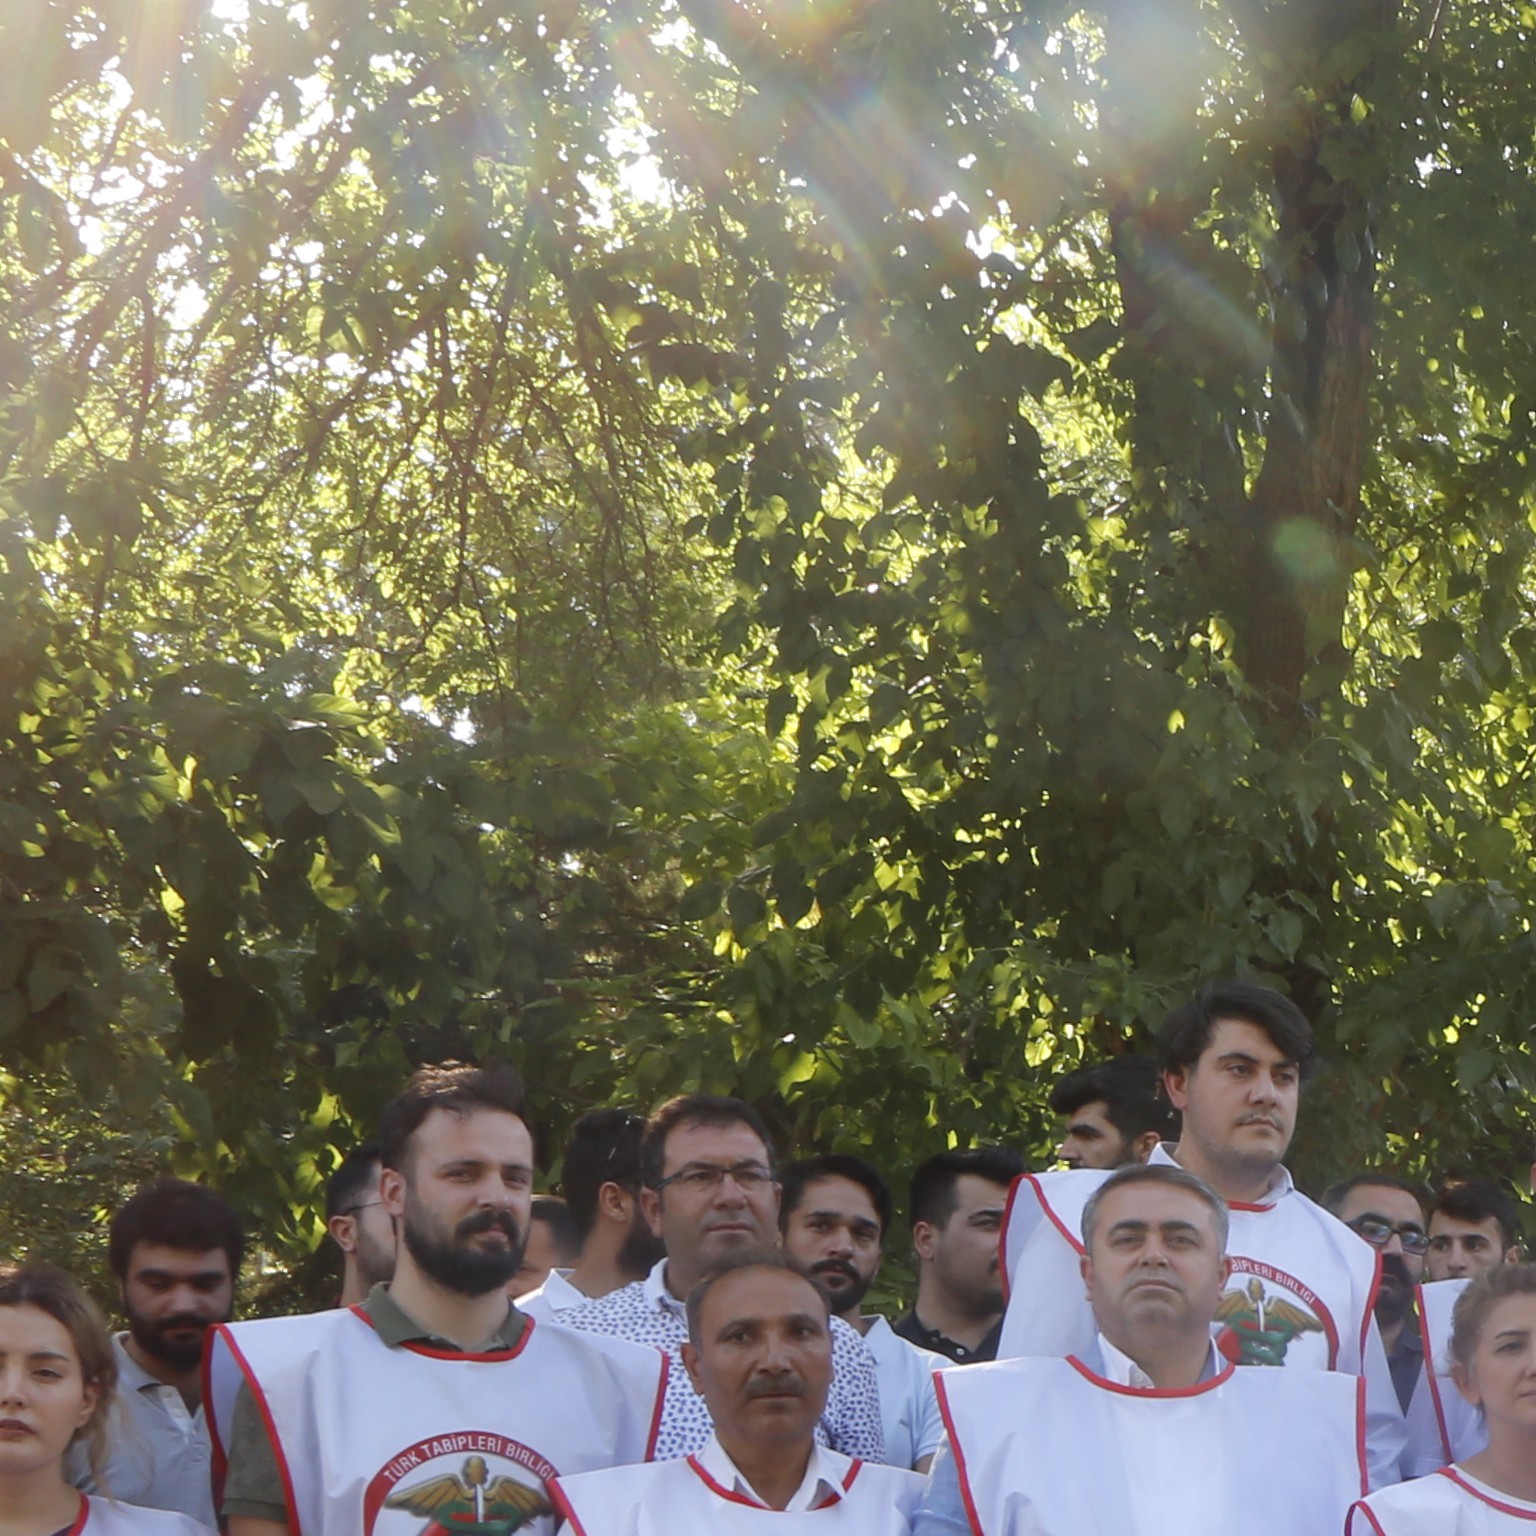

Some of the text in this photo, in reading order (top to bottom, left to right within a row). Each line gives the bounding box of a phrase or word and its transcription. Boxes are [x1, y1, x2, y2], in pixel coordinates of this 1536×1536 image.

[383, 1434, 556, 1483] TÜRK TABİPLERİ BİRLİĞİ
